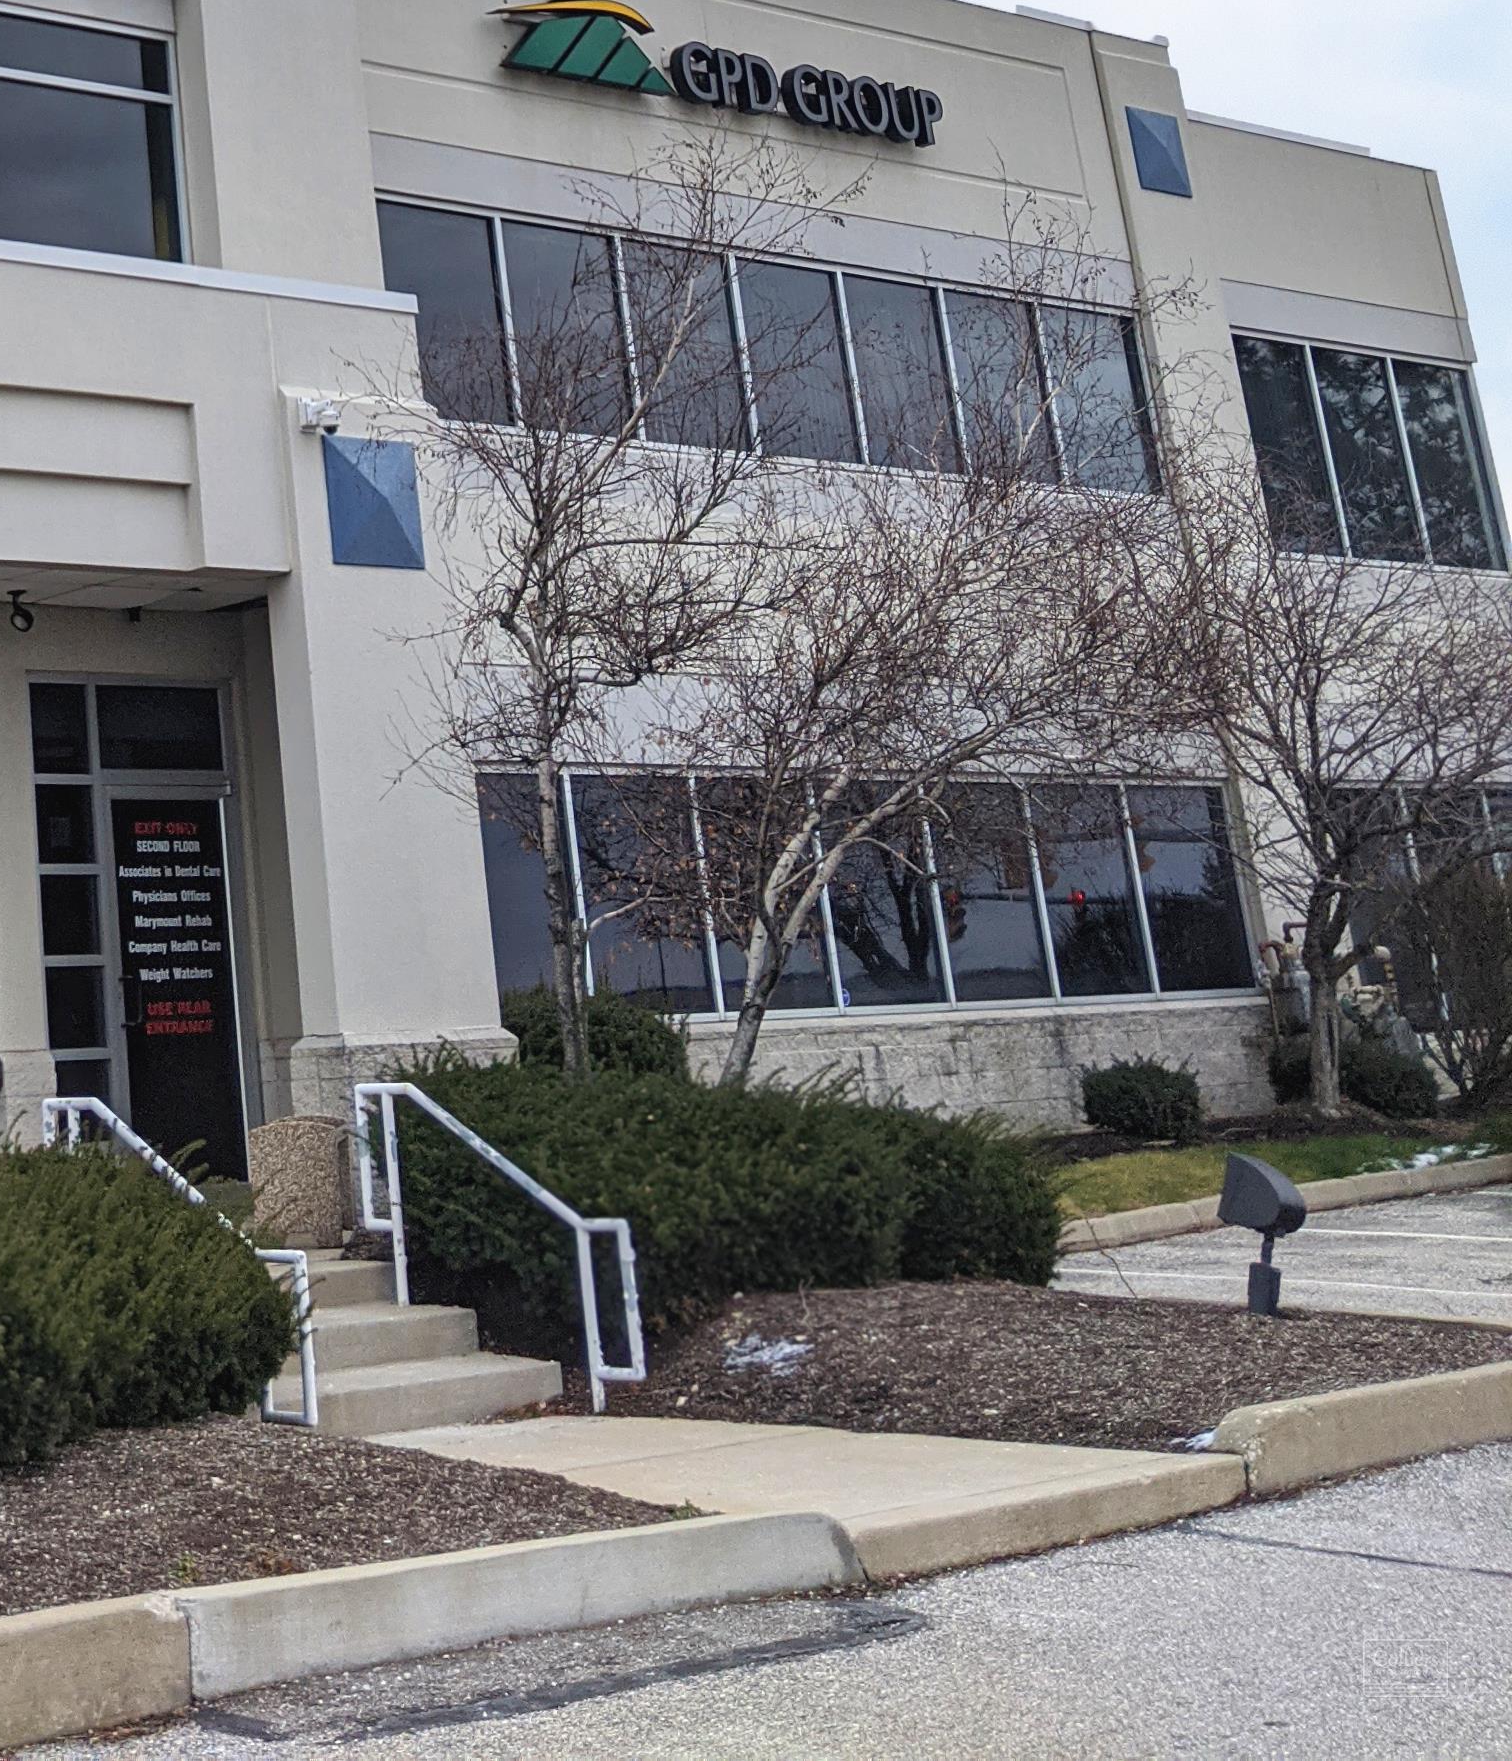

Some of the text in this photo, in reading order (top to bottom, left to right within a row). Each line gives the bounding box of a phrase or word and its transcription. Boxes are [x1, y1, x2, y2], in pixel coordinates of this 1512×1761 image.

[670, 41, 943, 148] GPD GROUP
[137, 841, 200, 852] SECOND FLOOR
[119, 865, 162, 877] Associates
[175, 865, 200, 877] Dental
[203, 865, 221, 877] Care
[132, 890, 211, 905] Physicians Offices
[134, 914, 212, 930] Marymount Rehab
[129, 939, 221, 955] Company Health Care
[139, 967, 213, 983] Weight Watchers
